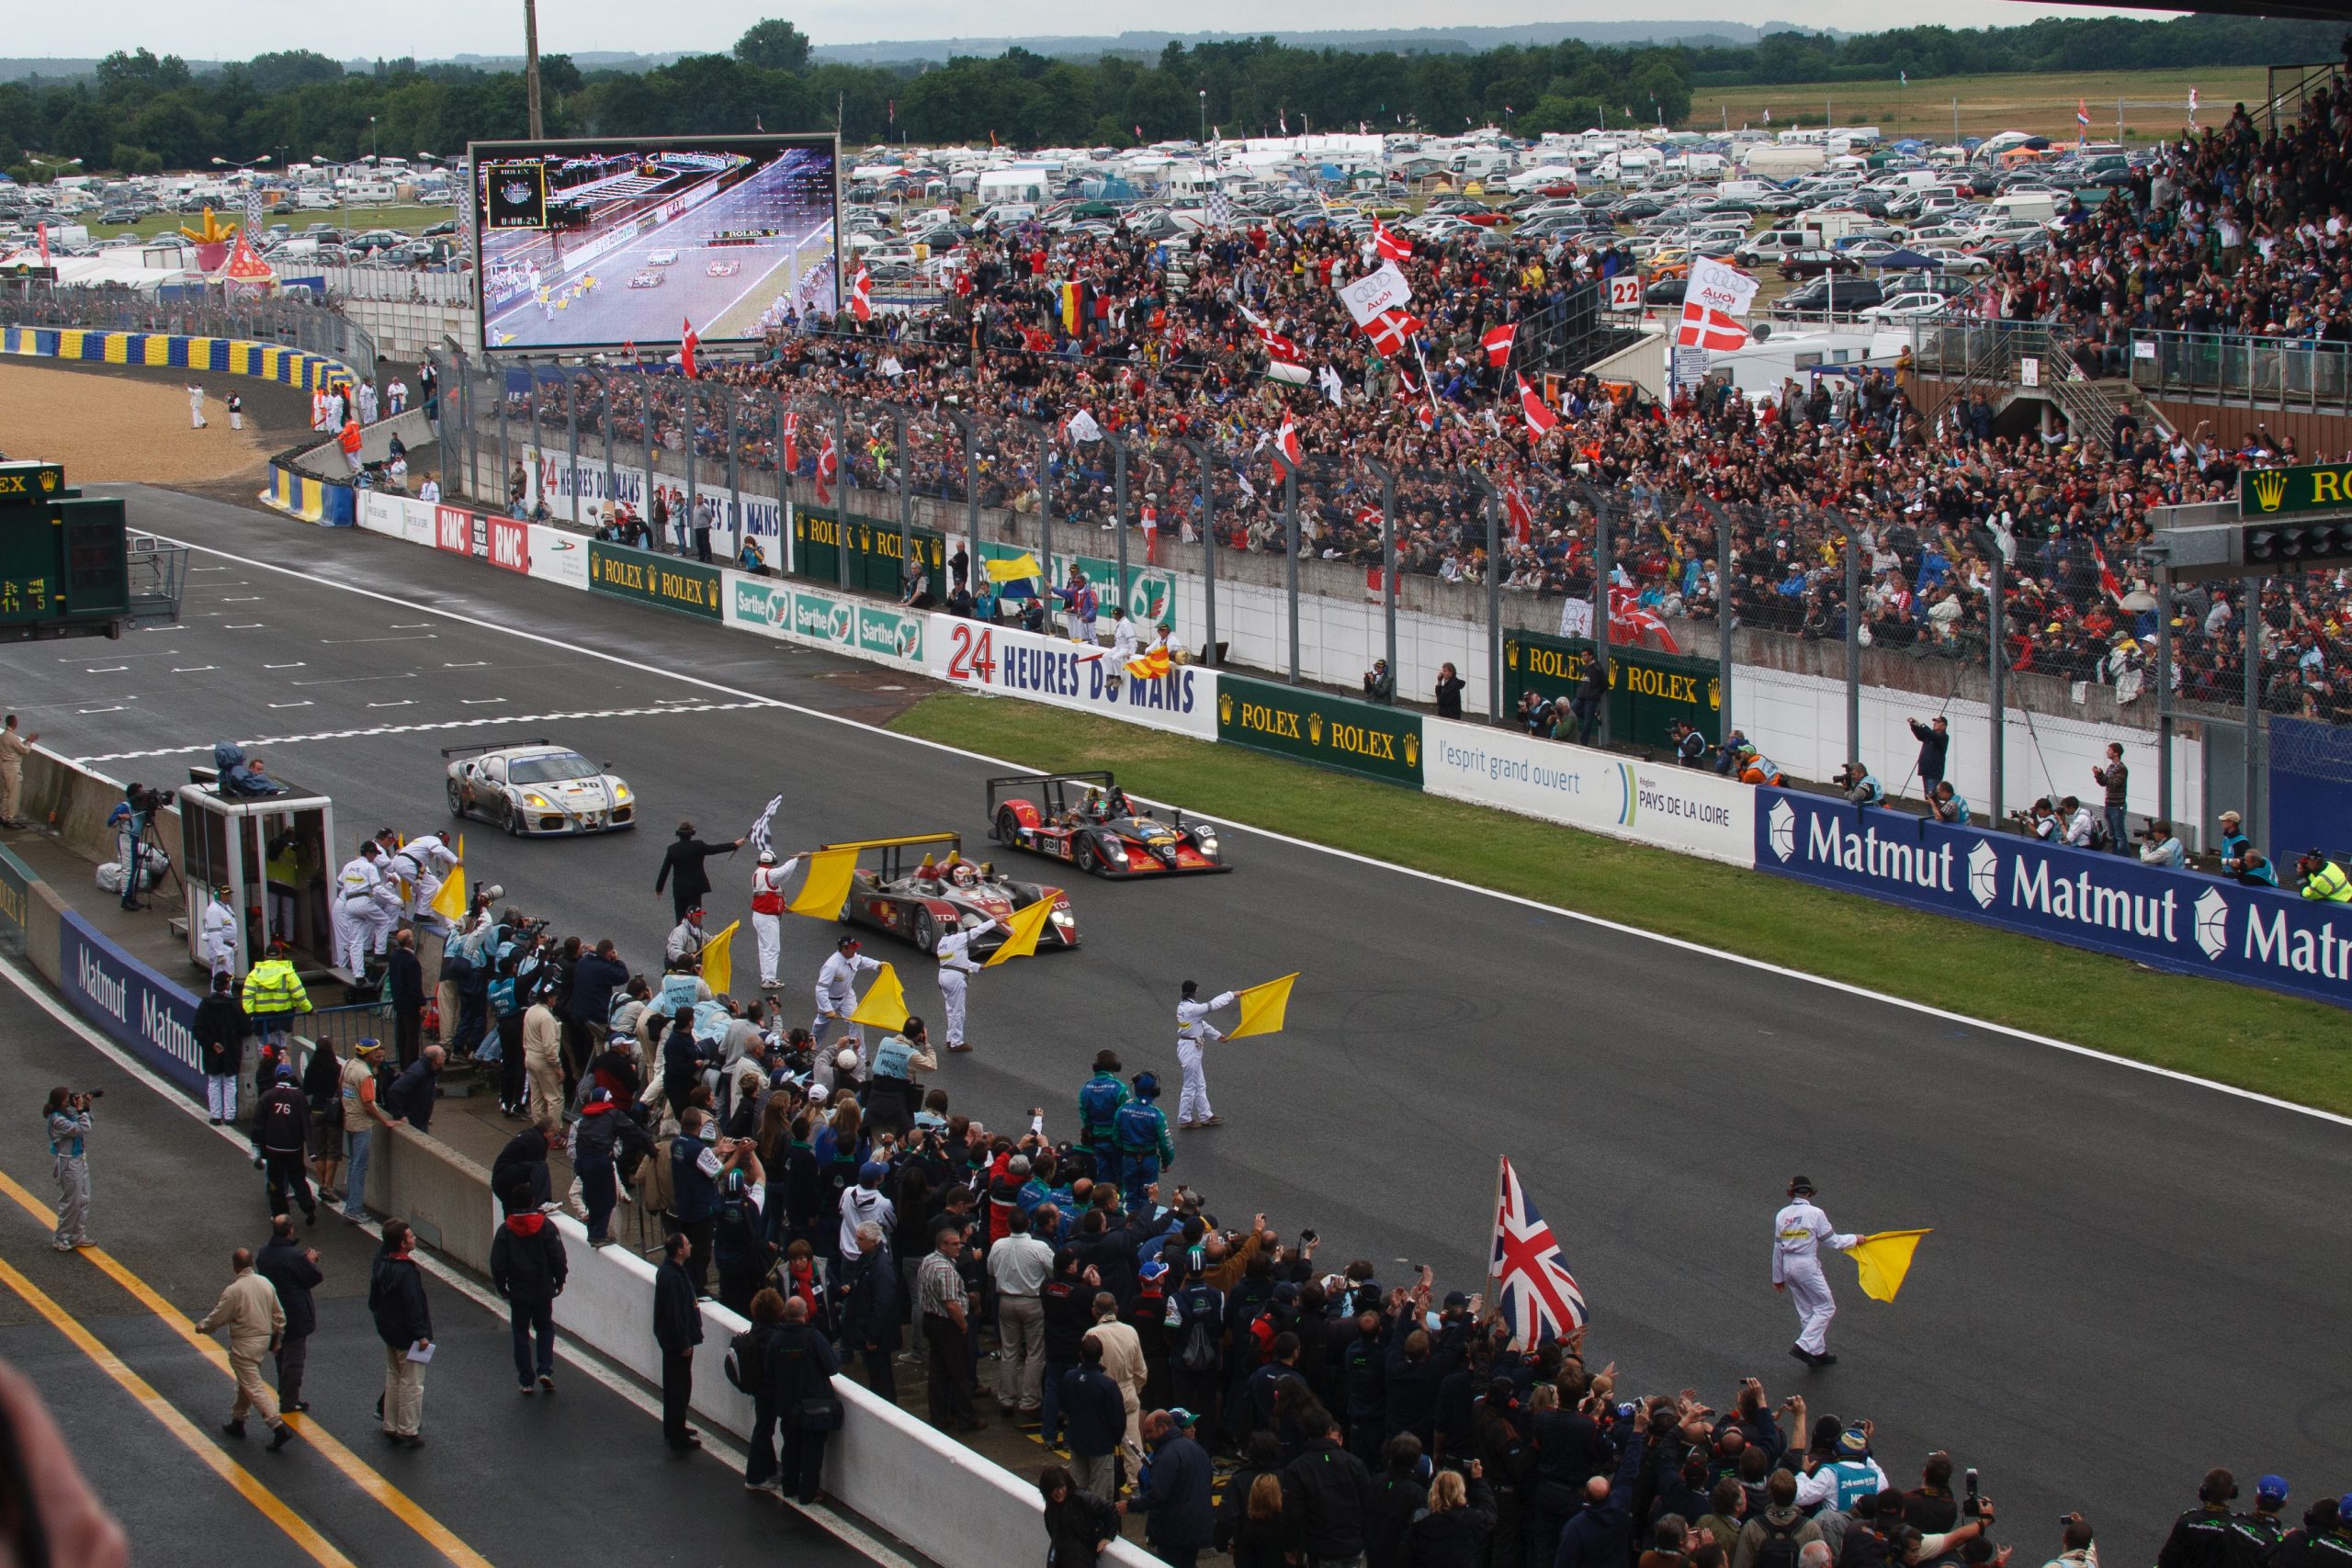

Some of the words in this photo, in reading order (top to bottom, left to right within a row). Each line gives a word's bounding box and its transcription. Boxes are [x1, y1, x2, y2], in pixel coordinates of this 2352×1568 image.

[1367, 291, 1392, 312] Audi
[1613, 283, 1638, 304] 22
[1702, 288, 1736, 304] Audi
[560, 468, 593, 497] HERES
[441, 509, 465, 551] RMC
[728, 502, 741, 532] D
[748, 503, 779, 536] MANS
[495, 525, 522, 569] RMC
[876, 532, 924, 564] ROLX
[605, 558, 642, 590] ROLEX
[662, 573, 703, 604] ROLEX
[739, 591, 765, 616] Sarthe
[797, 604, 826, 630] Sarthe
[862, 618, 894, 646] Sarthe
[946, 623, 997, 684] 24
[1004, 645, 1079, 697] HEURES
[1130, 669, 1194, 714] MANS
[1628, 667, 1698, 704] ROLEX
[1241, 703, 1301, 739] ROLEX
[1332, 723, 1396, 761] ROLEX
[1440, 739, 1486, 773] l'esprit
[1490, 757, 1529, 781] grand
[1533, 766, 1580, 795] ouvert
[1639, 776, 1656, 788] Région
[1639, 790, 1665, 812] PAYS
[1668, 797, 1681, 817] DE
[1683, 799, 1697, 819] LA
[1700, 803, 1730, 827] LOIRE
[1808, 811, 1954, 892] Matmut
[2012, 854, 2177, 942] Matmut
[1053, 901, 1070, 910] TDI
[79, 942, 127, 1024] Matmut
[276, 1103, 291, 1114] 76
[1841, 1480, 1853, 1489] 24
